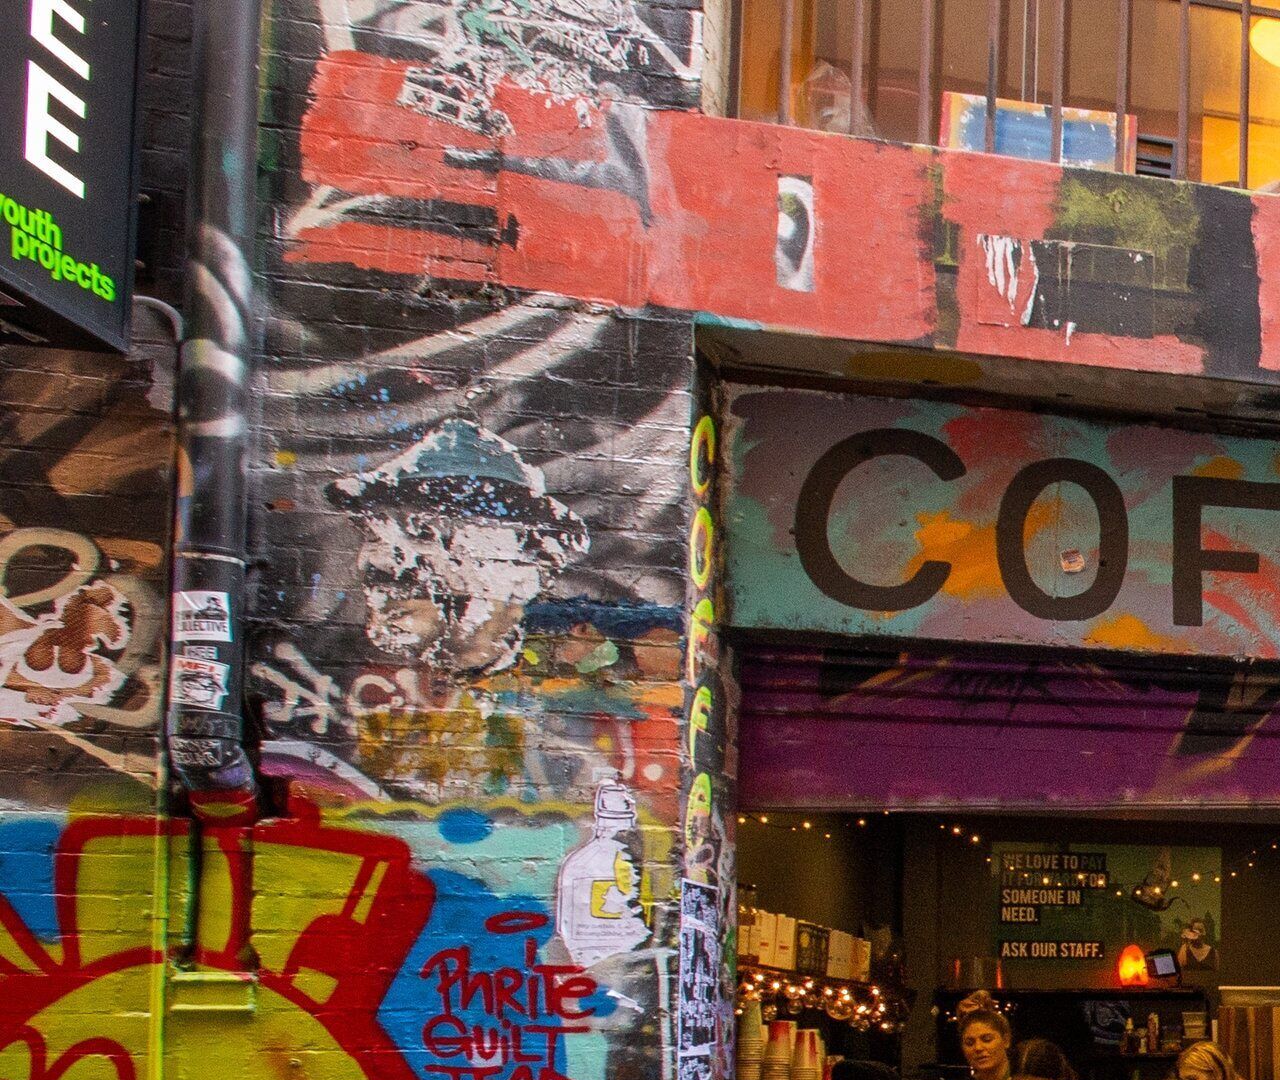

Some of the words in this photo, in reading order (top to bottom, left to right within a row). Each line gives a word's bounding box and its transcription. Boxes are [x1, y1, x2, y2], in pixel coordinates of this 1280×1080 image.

[10, 225, 115, 302] projects
[1002, 854, 1022, 869] WE
[1026, 854, 1059, 870] LOVE
[1064, 855, 1079, 870] TO
[1002, 889, 1064, 905] SOMEONE
[1067, 889, 1080, 904] IN
[1001, 906, 1038, 922] NEED.
[1002, 943, 1029, 957] ASK
[1031, 943, 1056, 958] OUR
[1060, 943, 1103, 958] STAFF.
